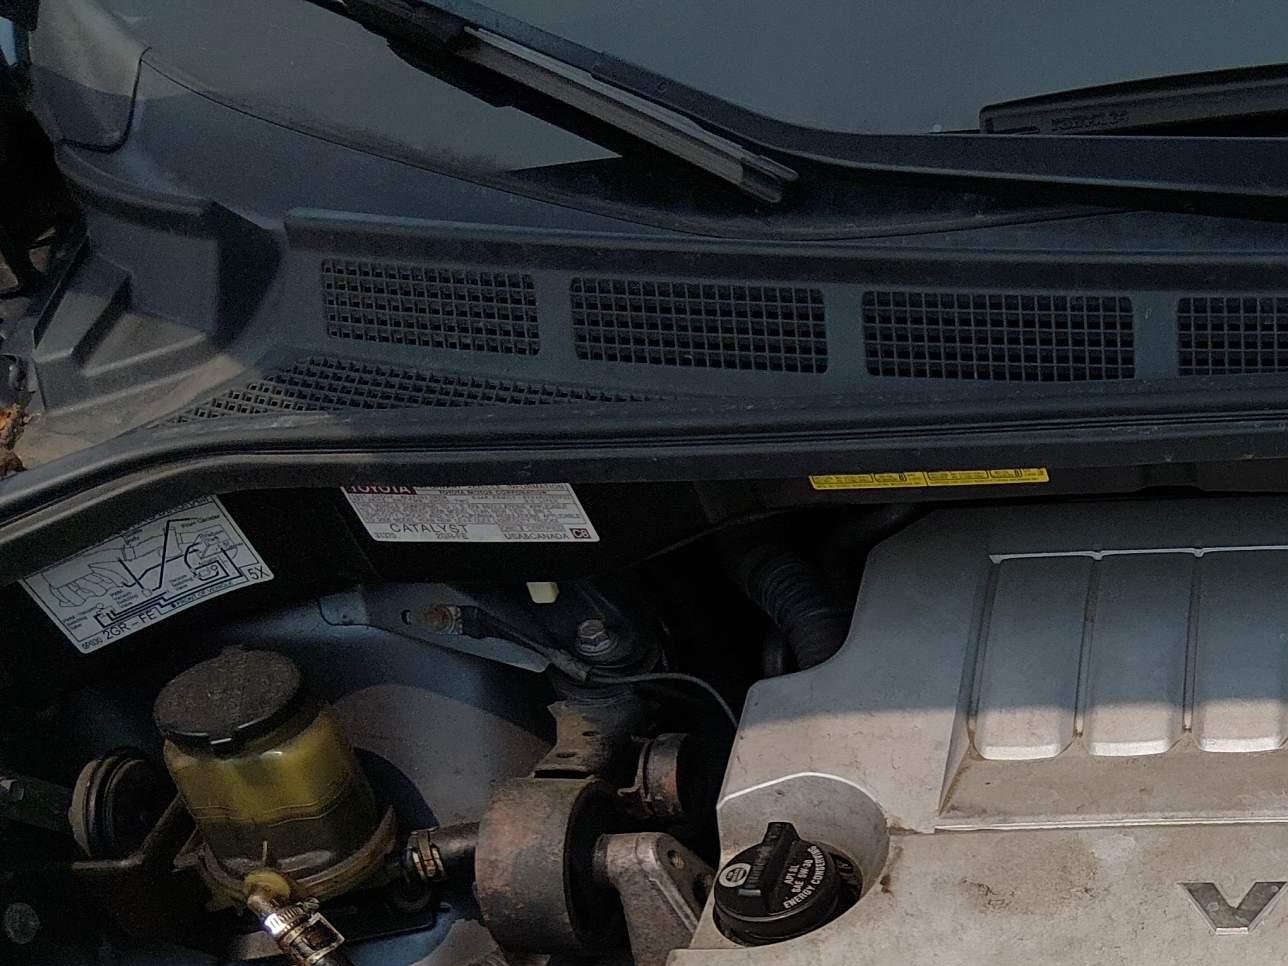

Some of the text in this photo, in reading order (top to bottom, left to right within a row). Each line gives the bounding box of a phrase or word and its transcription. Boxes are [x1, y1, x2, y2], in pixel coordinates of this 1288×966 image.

[390, 523, 469, 533] CATALYST
[248, 565, 270, 581] 5X
[791, 881, 804, 893] SAE
[783, 885, 816, 909] ENERGY
